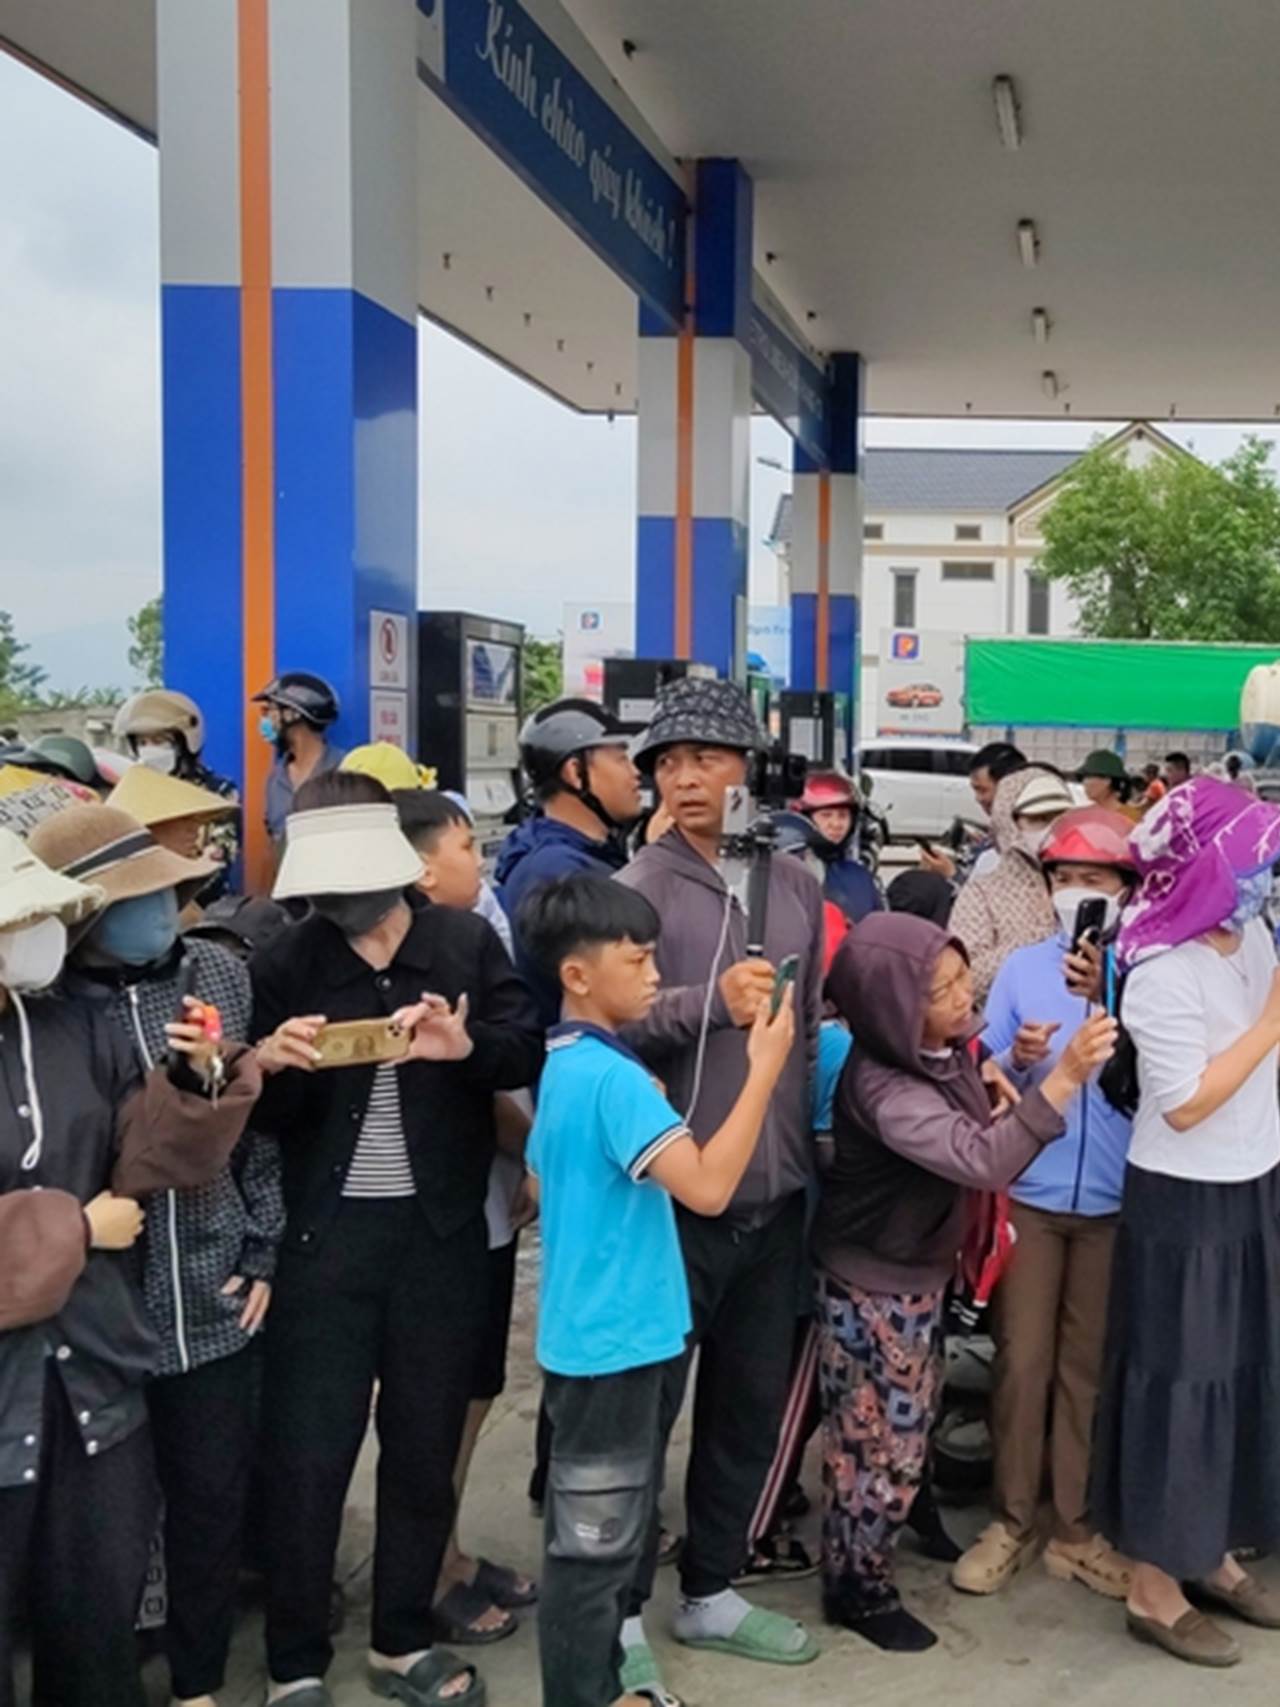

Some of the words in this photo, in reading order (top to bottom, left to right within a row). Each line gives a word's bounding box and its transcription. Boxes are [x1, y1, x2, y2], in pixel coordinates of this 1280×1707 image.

[475, 0, 538, 119] Kính
[541, 77, 586, 168] chào
[589, 145, 622, 220] quý
